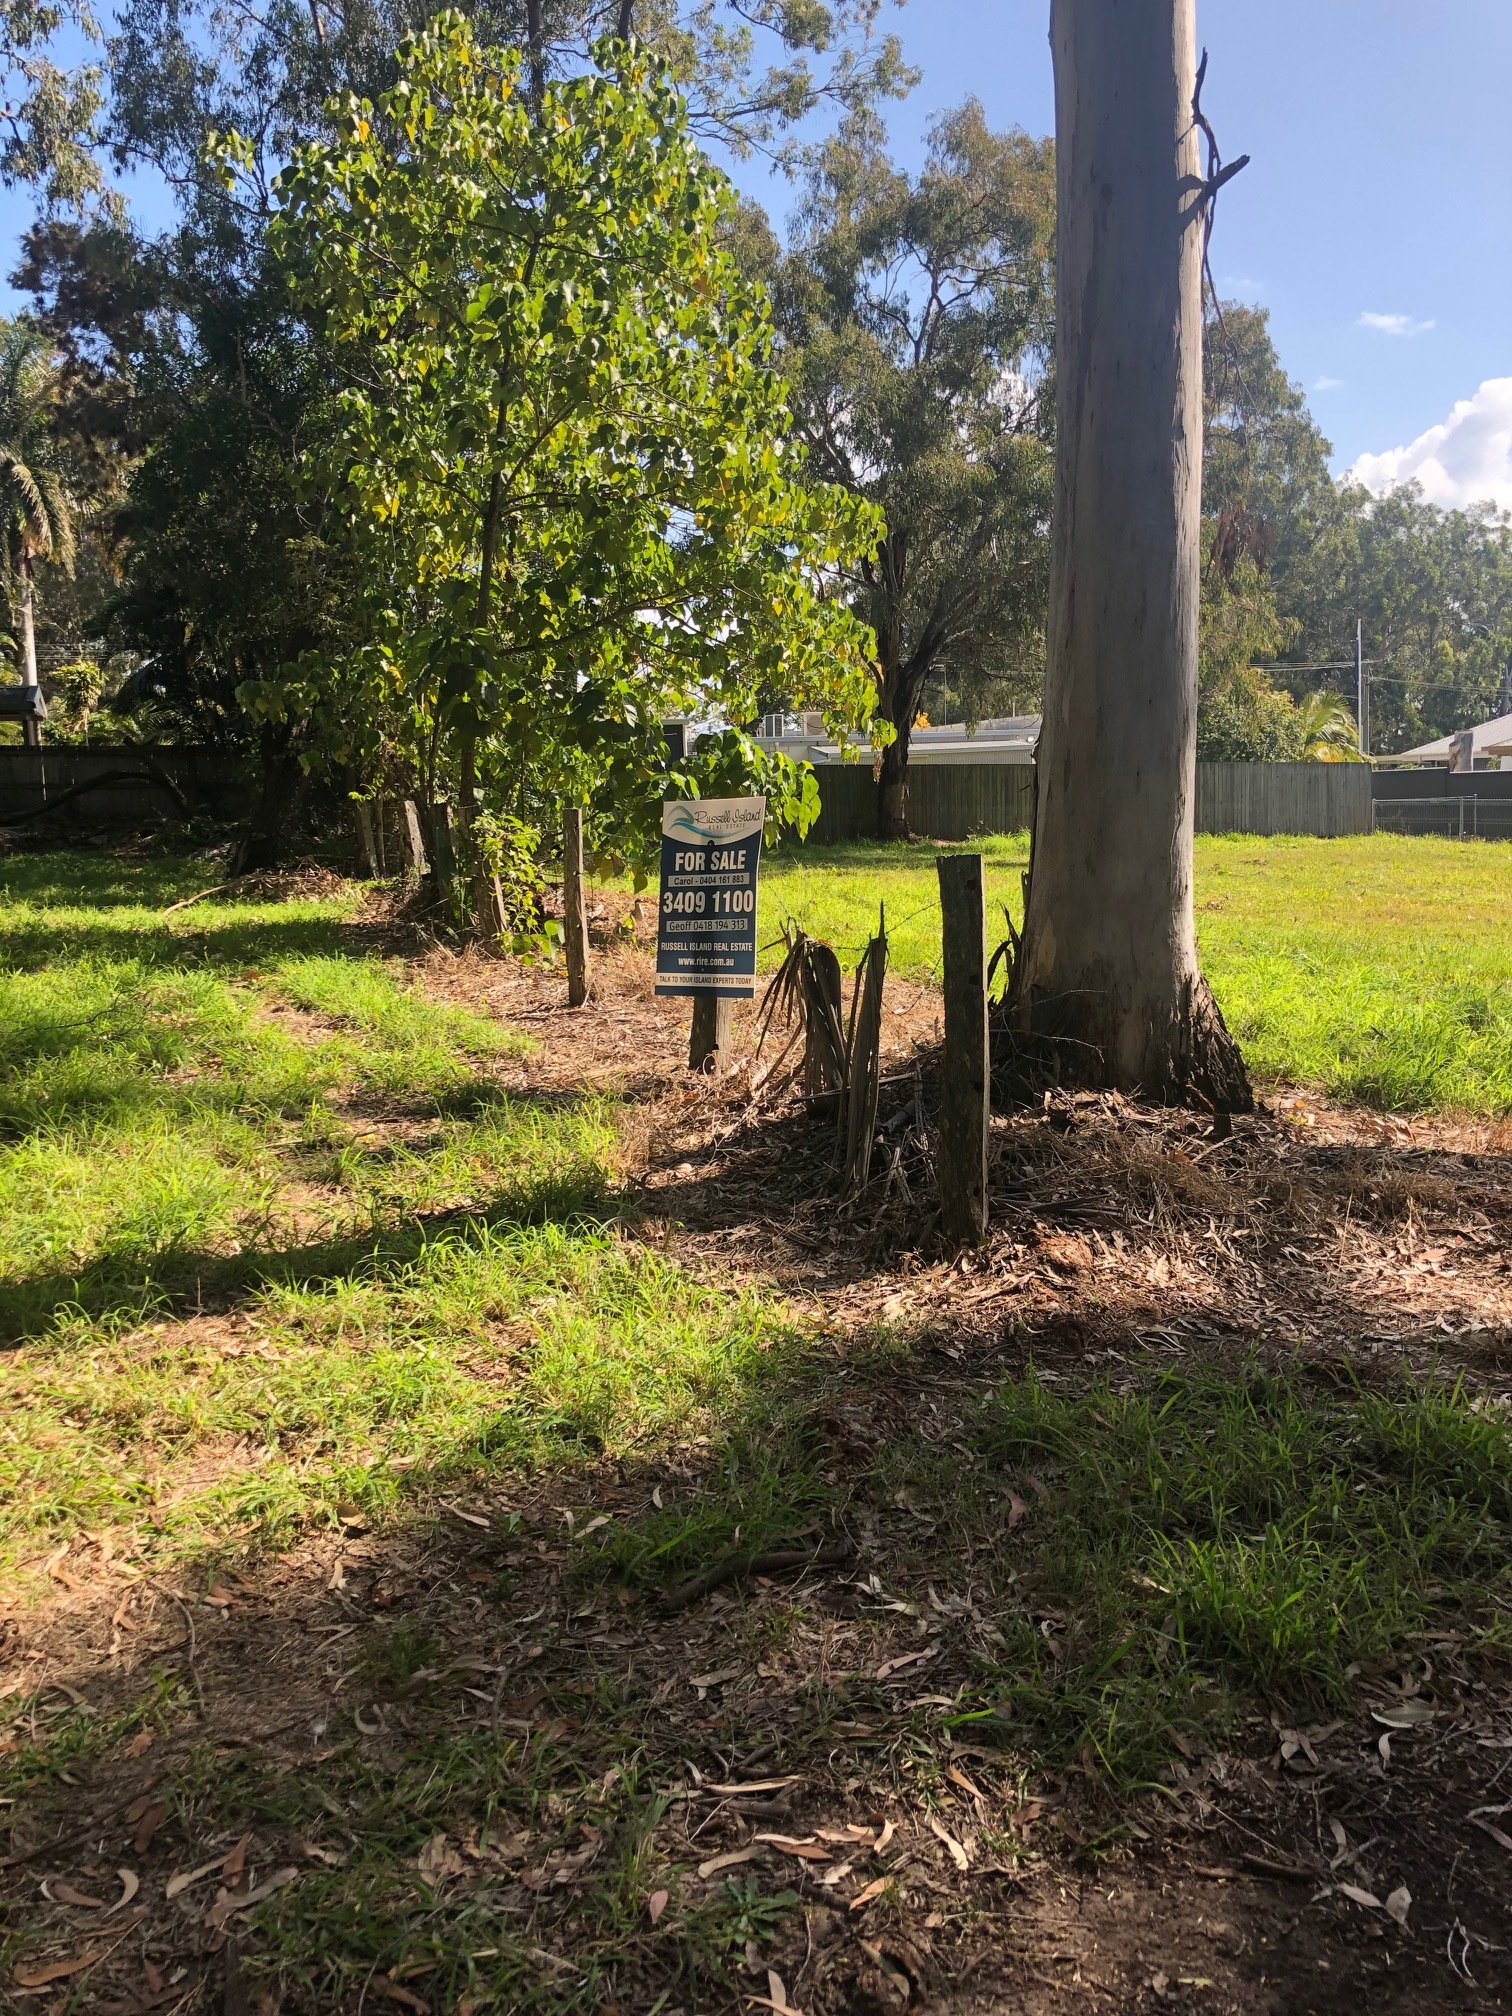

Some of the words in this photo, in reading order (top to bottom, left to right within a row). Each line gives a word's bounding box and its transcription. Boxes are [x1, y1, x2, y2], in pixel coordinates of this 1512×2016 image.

[694, 810, 731, 824] Russell
[732, 808, 761, 823] Island
[675, 851, 706, 872] FOR
[710, 849, 747, 871] SALE
[674, 877, 693, 886] Carol
[700, 876, 717, 885] 0404
[719, 875, 730, 884] 161
[732, 875, 744, 883] 883
[662, 891, 706, 914] 3409
[712, 889, 754, 913] 1100
[669, 921, 691, 931] Geoff
[693, 921, 713, 931] 0418
[715, 920, 729, 930] 194
[731, 920, 745, 930] 313
[661, 942, 688, 951] RUSSELL
[689, 942, 712, 951] ISLAND
[713, 942, 729, 951] REAL
[730, 942, 753, 952] ESTATE
[678, 956, 734, 966] www.rire.com.au
[659, 975, 671, 983] TALK
[693, 976, 711, 984] ISLAND
[735, 977, 751, 985] TODAY
